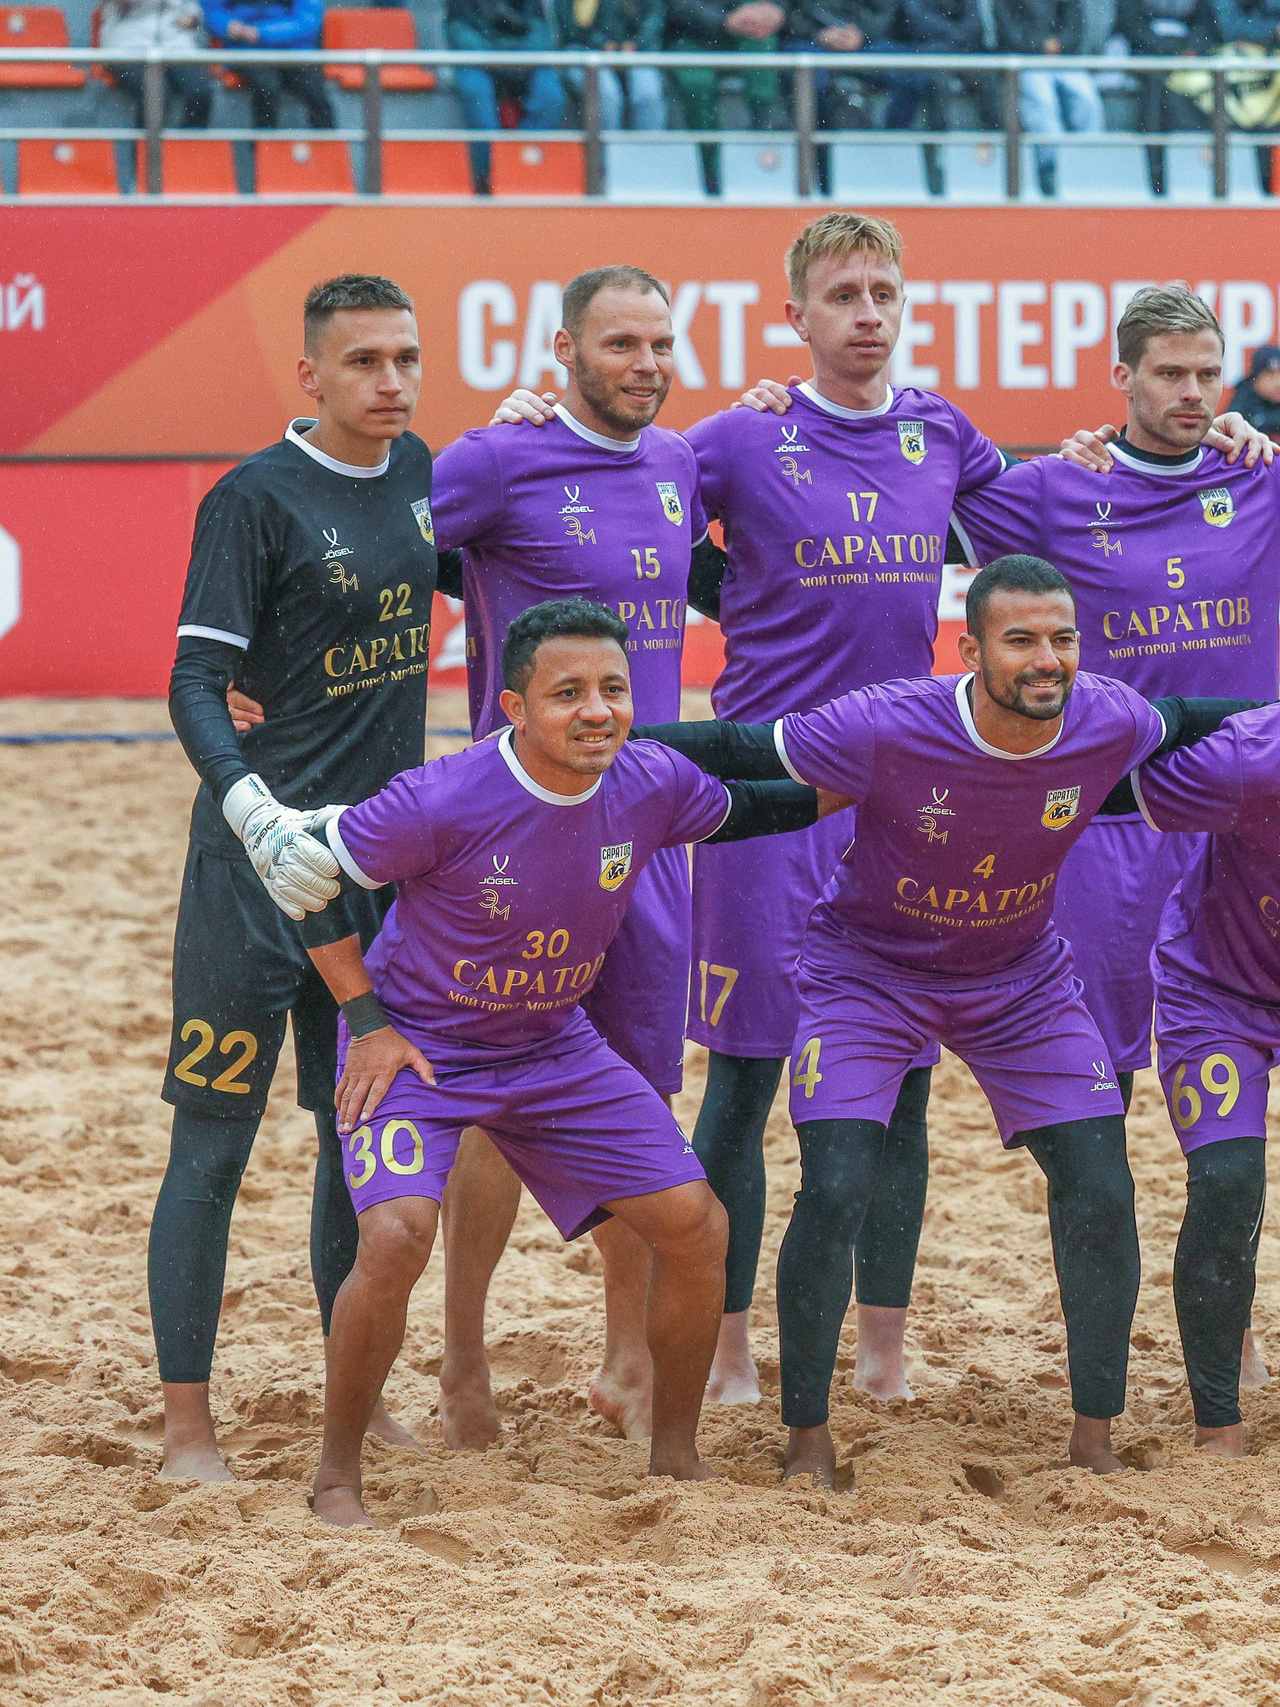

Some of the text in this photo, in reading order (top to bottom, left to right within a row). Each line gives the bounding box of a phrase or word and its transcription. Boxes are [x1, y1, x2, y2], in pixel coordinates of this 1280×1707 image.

[899, 423, 923, 434] САРАТОВ
[558, 505, 595, 514] JÖGEL
[846, 492, 879, 522] 17
[321, 547, 354, 560] JÖGEL
[631, 548, 661, 580] 15
[795, 534, 941, 568] САРАТОВ
[800, 574, 827, 588] МОЙ
[831, 573, 869, 585] ГОРОД
[875, 572, 899, 583] МОЯ
[1167, 557, 1186, 589] 5
[379, 583, 412, 622] 22
[1103, 597, 1251, 640] САРАТОВ
[324, 623, 430, 678] САРАТО
[1109, 646, 1135, 660] МОЙ
[1138, 642, 1177, 655] ГОРОД
[1182, 639, 1207, 651] МОЯ
[1047, 787, 1079, 802] САРАТОВ
[917, 805, 956, 816] JÖGEL
[602, 844, 631, 860] САРАТОВ
[479, 876, 518, 885] JÖGEL
[973, 854, 996, 879] 4
[893, 901, 920, 918] МОЙ
[923, 912, 963, 928] ГОРОД
[969, 918, 996, 928] МОЯ
[522, 929, 570, 959] 30
[448, 990, 478, 1007] МОЙ
[526, 1001, 553, 1011] МОЯ
[699, 960, 739, 1027] 17
[174, 1018, 258, 1094] 22
[793, 1037, 823, 1098] 4
[1090, 1082, 1118, 1092] JÖGEL
[1172, 1053, 1240, 1129] 69
[349, 1119, 424, 1189] 30
